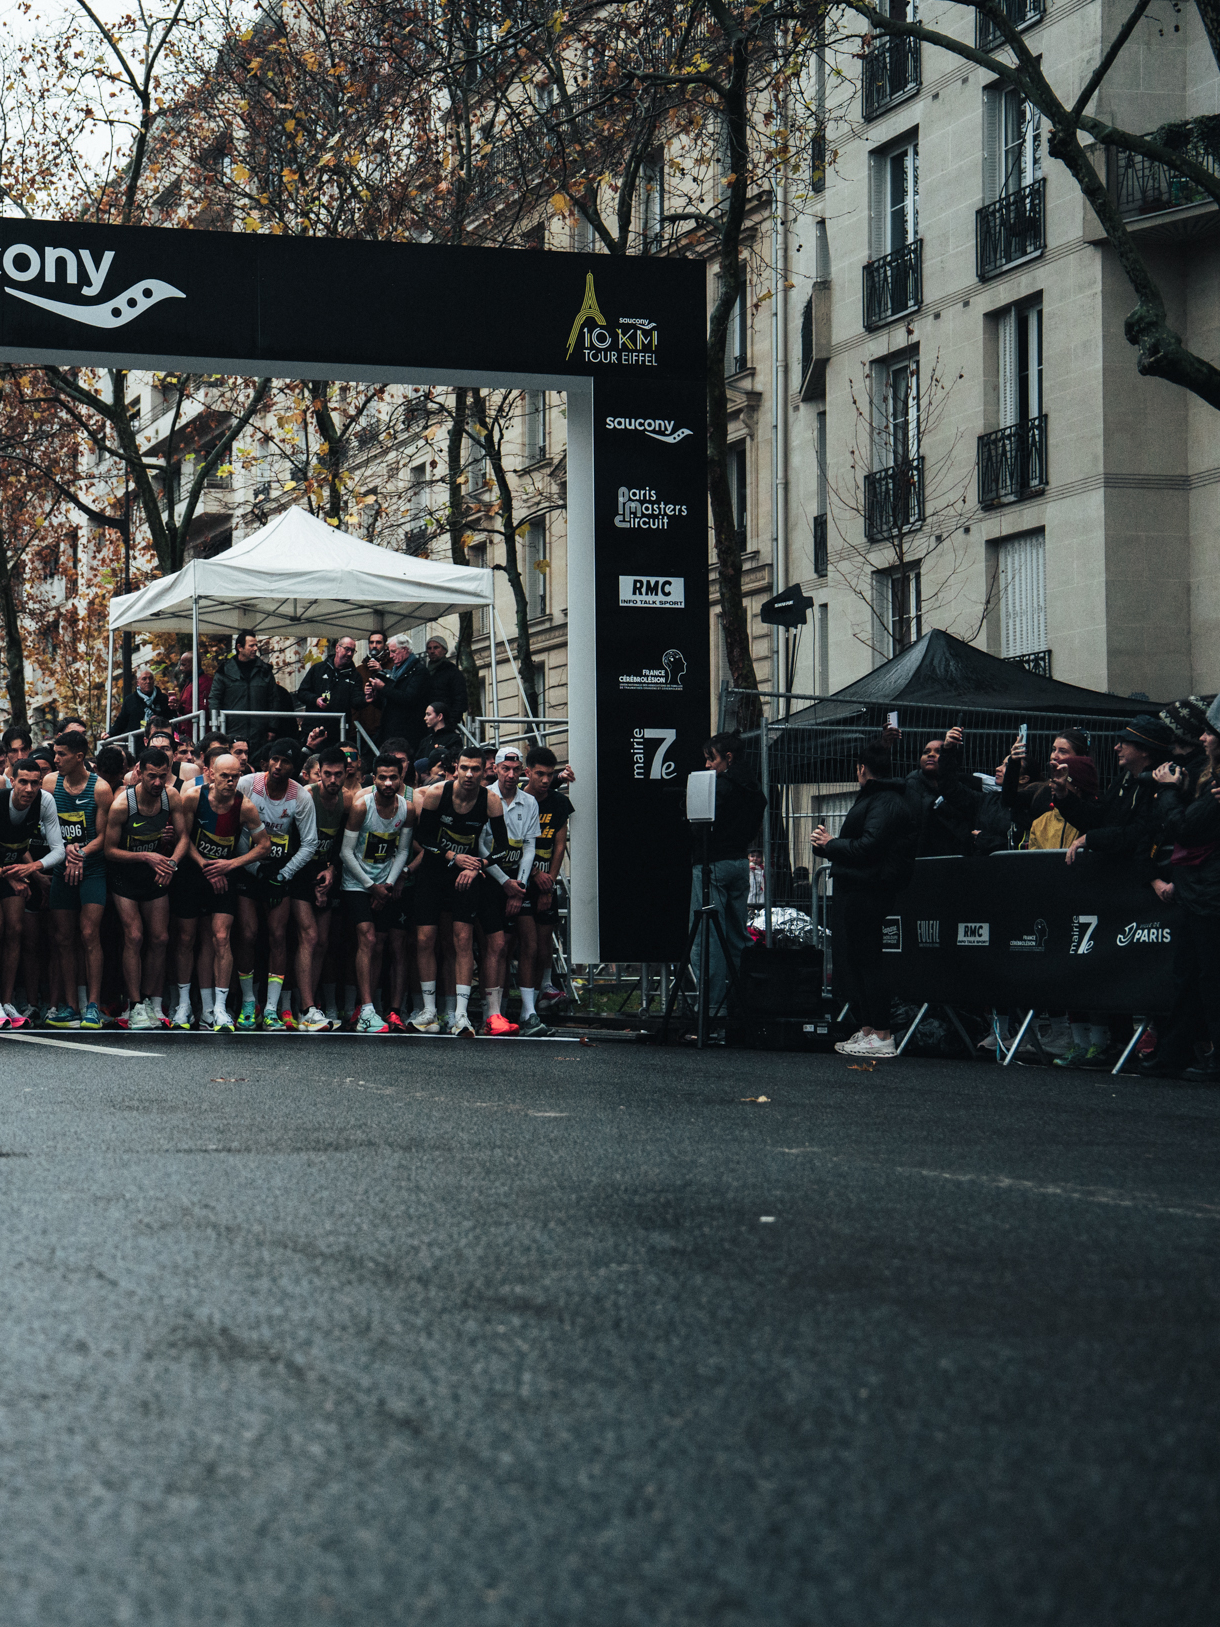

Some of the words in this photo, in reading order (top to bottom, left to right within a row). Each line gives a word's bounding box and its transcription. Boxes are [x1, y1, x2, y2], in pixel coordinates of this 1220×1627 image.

[619, 317, 649, 326] saucony
[583, 327, 612, 348] 10
[616, 328, 658, 350] KM
[583, 350, 618, 364] TOUR
[622, 352, 658, 366] EIFFEL
[605, 416, 675, 434] saucony
[632, 579, 673, 596] RMC
[630, 728, 644, 779] mairie
[4, 852, 18, 861] 29
[198, 841, 229, 857] 22234
[378, 843, 388, 854] 17
[916, 920, 940, 943] FULFIL
[963, 925, 984, 938] RMC
[1069, 915, 1080, 954] mairie
[1133, 928, 1172, 943] PARIS
